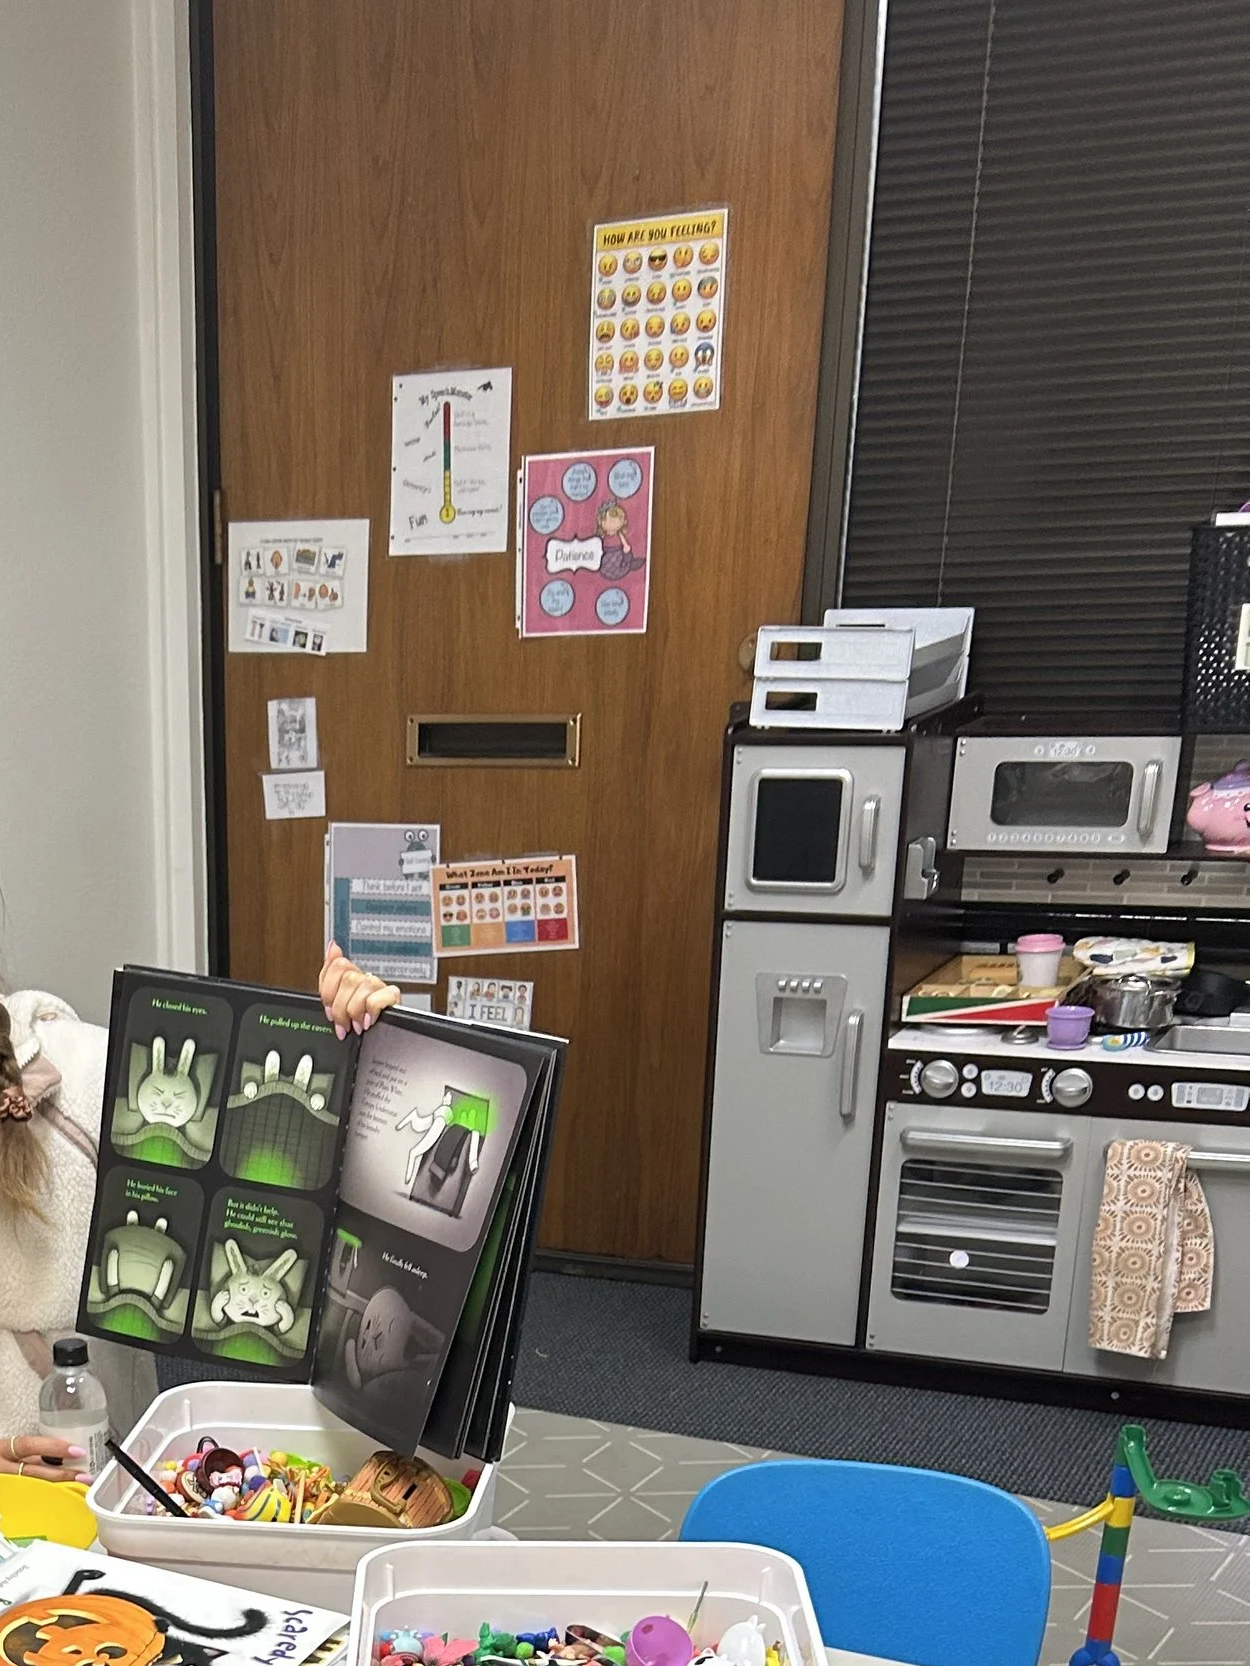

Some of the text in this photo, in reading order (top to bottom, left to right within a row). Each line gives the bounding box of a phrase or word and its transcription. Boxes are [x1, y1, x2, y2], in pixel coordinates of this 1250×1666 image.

[603, 220, 718, 246] HOW ARE YOU FEELING?
[408, 513, 429, 530] Fun
[554, 547, 595, 563] Patience
[445, 870, 468, 880] What
[470, 868, 490, 878] Zone
[491, 867, 506, 876] Am
[512, 866, 522, 876] In
[523, 863, 554, 875] Today?
[362, 880, 382, 891] Think
[383, 881, 406, 893] before
[355, 921, 427, 936] Control my emotions
[152, 998, 162, 1008] He
[162, 999, 182, 1011] closed
[183, 1002, 192, 1013] his
[469, 1003, 508, 1022] I FEEL
[259, 1014, 270, 1024] He
[270, 1017, 291, 1027] pulled
[291, 1021, 300, 1030] up
[300, 1021, 311, 1031] the
[990, 1081, 1023, 1093] 12:30
[127, 1179, 178, 1196] He buried his face
[227, 1198, 239, 1209] But
[245, 1202, 263, 1213] didn't
[226, 1208, 237, 1218] He
[237, 1212, 256, 1221] could
[255, 1215, 268, 1224] still
[279, 1218, 294, 1229] that
[253, 1226, 280, 1236] greenish
[381, 1251, 390, 1262] He
